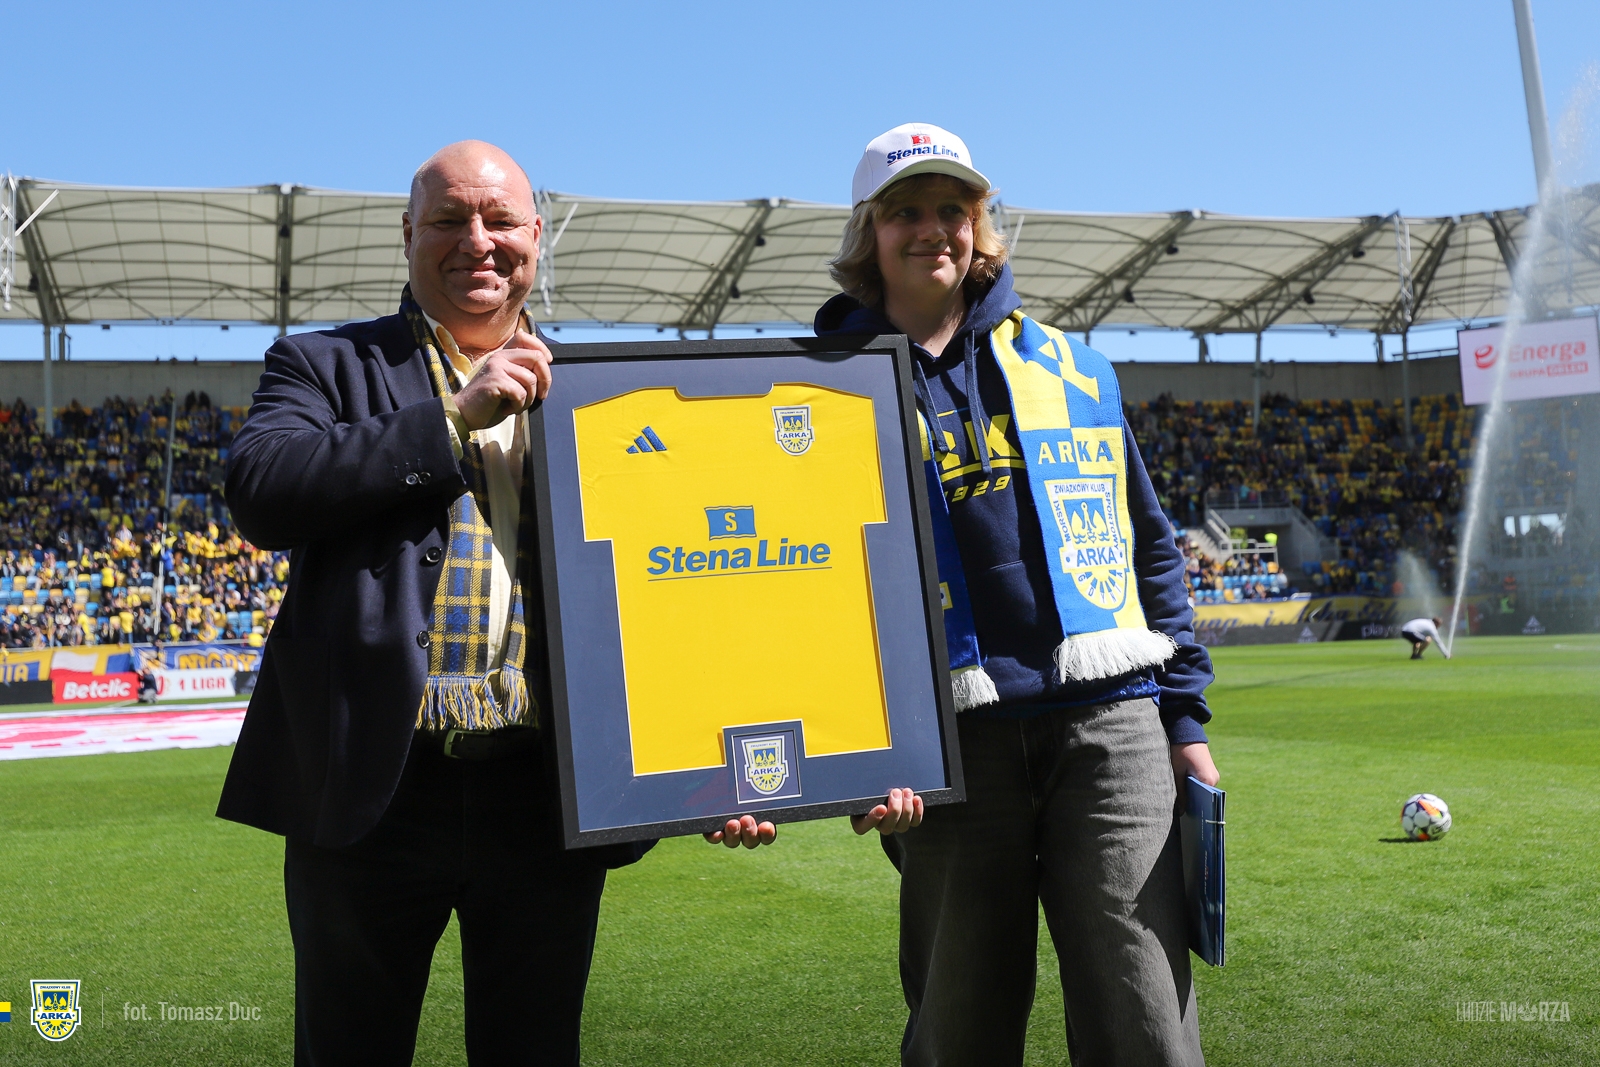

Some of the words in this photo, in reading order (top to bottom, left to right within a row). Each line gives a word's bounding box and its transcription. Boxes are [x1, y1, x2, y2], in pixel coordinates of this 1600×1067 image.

[887, 145, 932, 164] Stena
[933, 144, 959, 160] Line
[1508, 340, 1587, 362] Energa
[1038, 441, 1115, 465] ARKA
[1090, 483, 1106, 493] KLUB
[724, 511, 738, 532] S
[1053, 500, 1072, 542] MORSKI
[1105, 491, 1119, 551] SPORTOWY
[647, 545, 752, 575] Stena
[757, 538, 831, 567] Line
[1076, 546, 1118, 567] ARKA
[63, 678, 131, 700] Betclic
[193, 677, 226, 691] LIGA
[754, 767, 781, 775] ARKA
